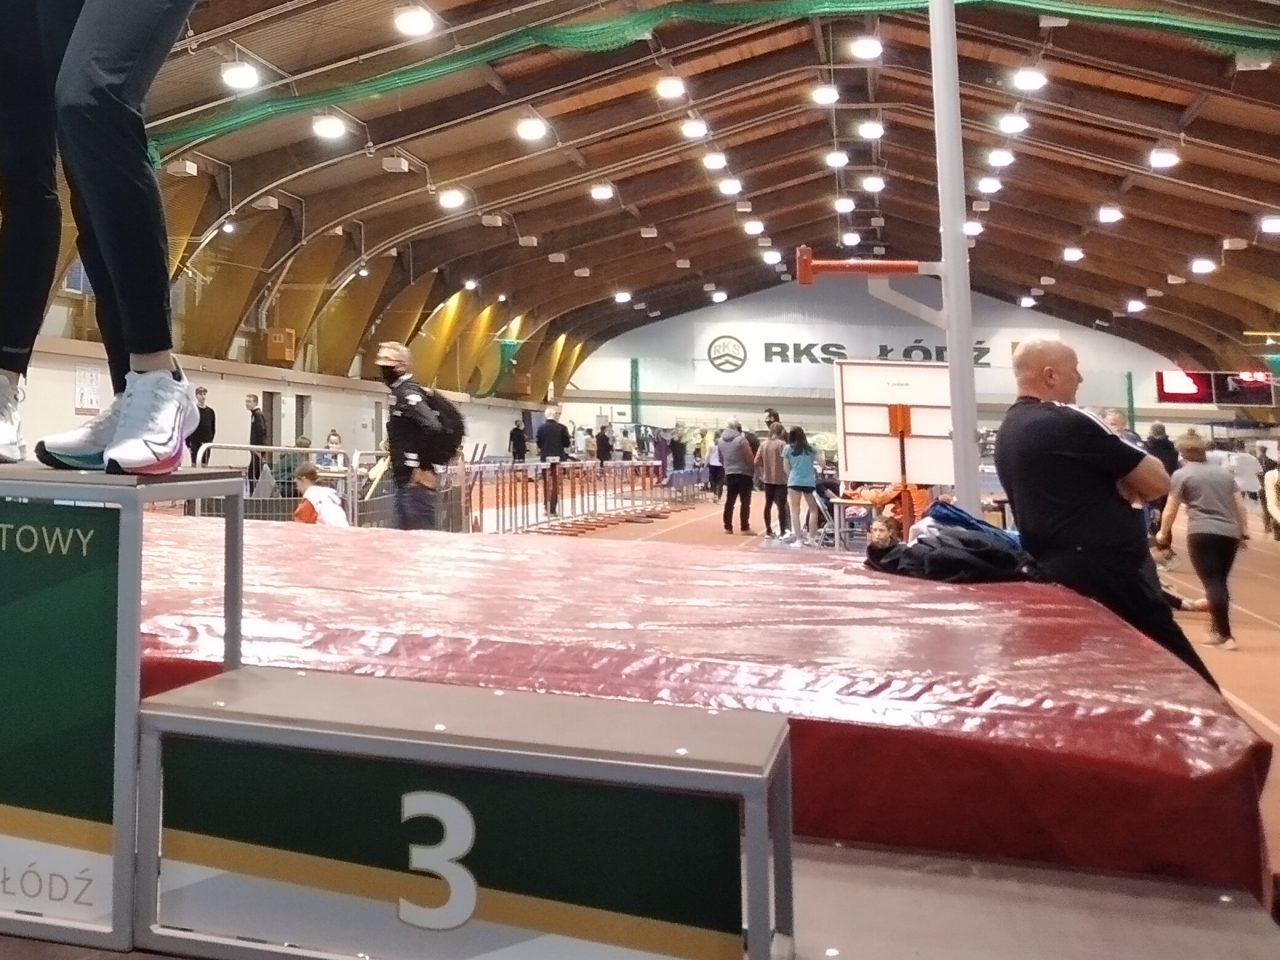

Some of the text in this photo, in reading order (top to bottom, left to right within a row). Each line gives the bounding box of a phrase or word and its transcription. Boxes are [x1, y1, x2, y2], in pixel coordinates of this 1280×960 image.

[713, 341, 740, 356] RKS
[764, 342, 848, 365] RKS
[396, 790, 478, 932] 3
[0, 861, 94, 907] ŁÓDŹ
